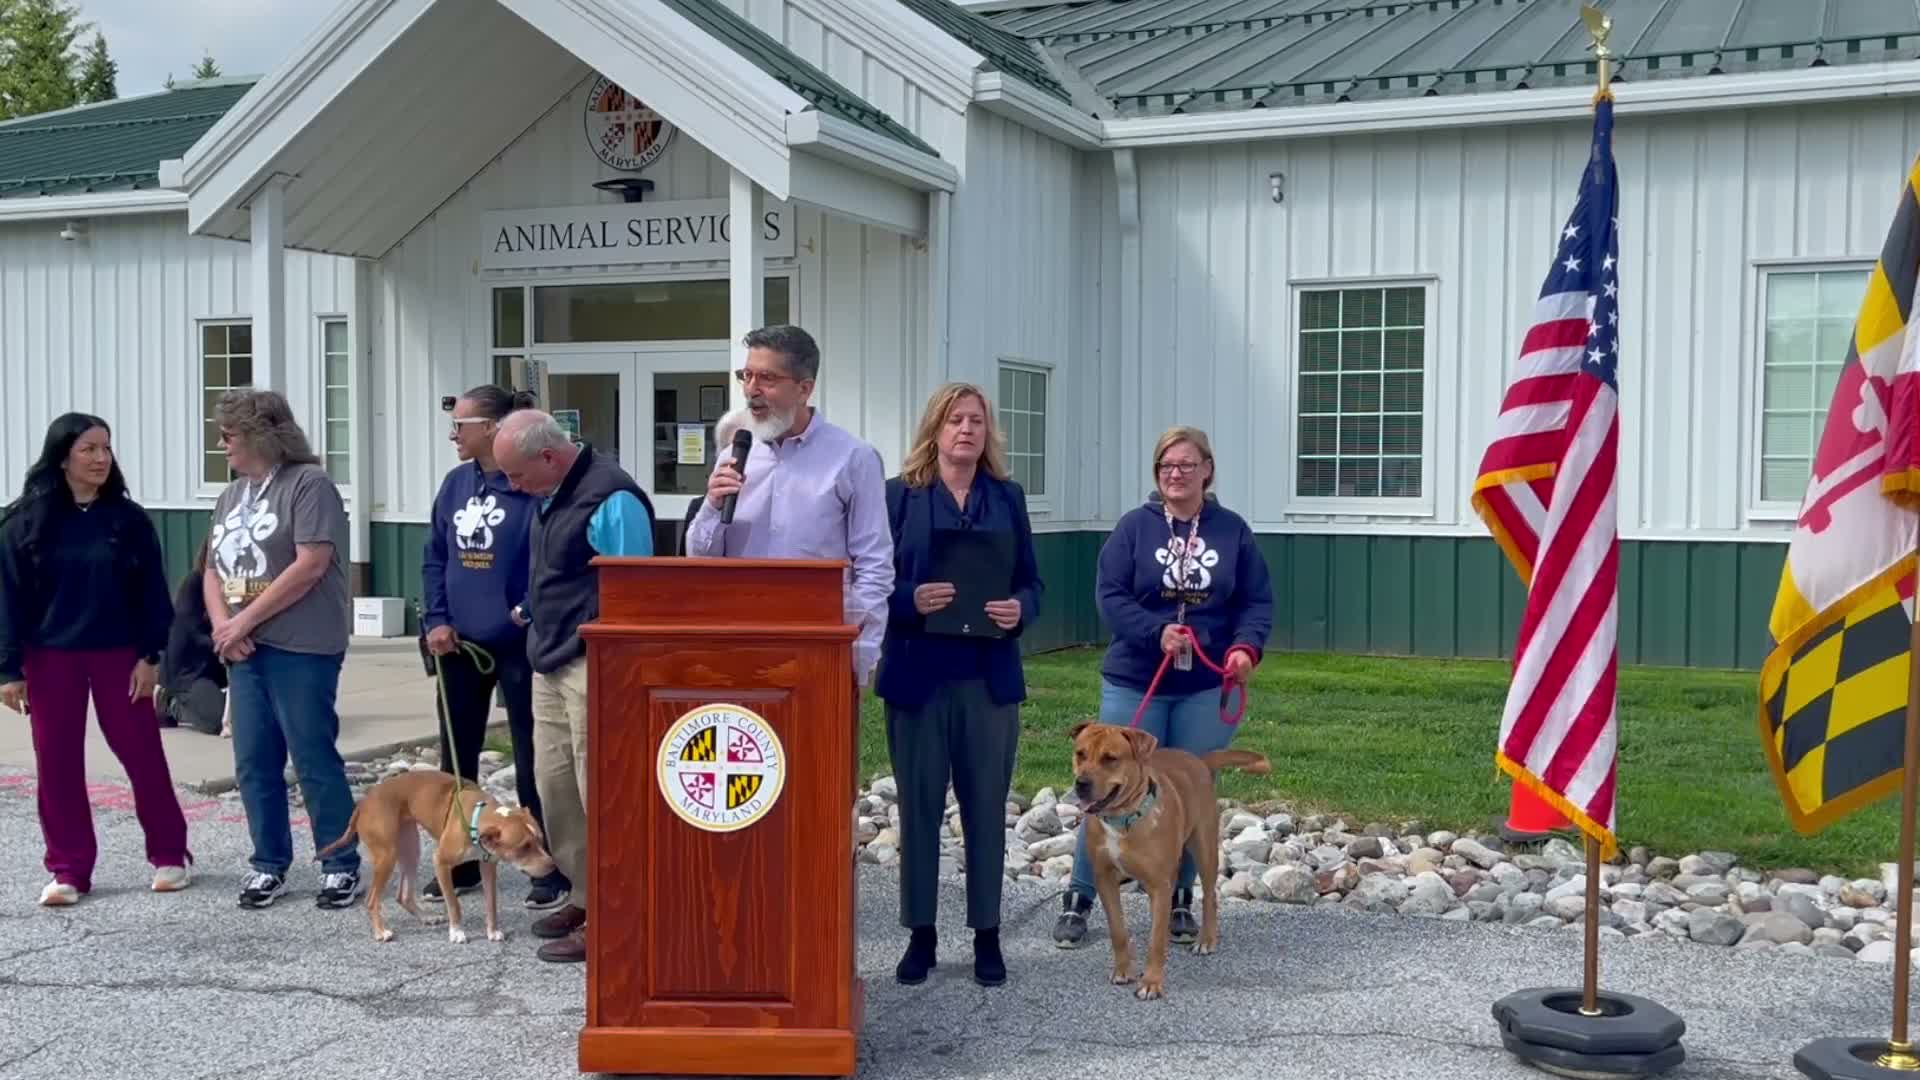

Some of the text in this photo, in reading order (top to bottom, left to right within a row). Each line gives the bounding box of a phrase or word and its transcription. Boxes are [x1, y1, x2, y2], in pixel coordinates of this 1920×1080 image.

[599, 143, 661, 168] MARYLAND
[494, 211, 781, 253] ANIMAL SERVICS
[666, 712, 778, 770] BALTIMORE COUNTY
[680, 796, 762, 823] MARYLAND
